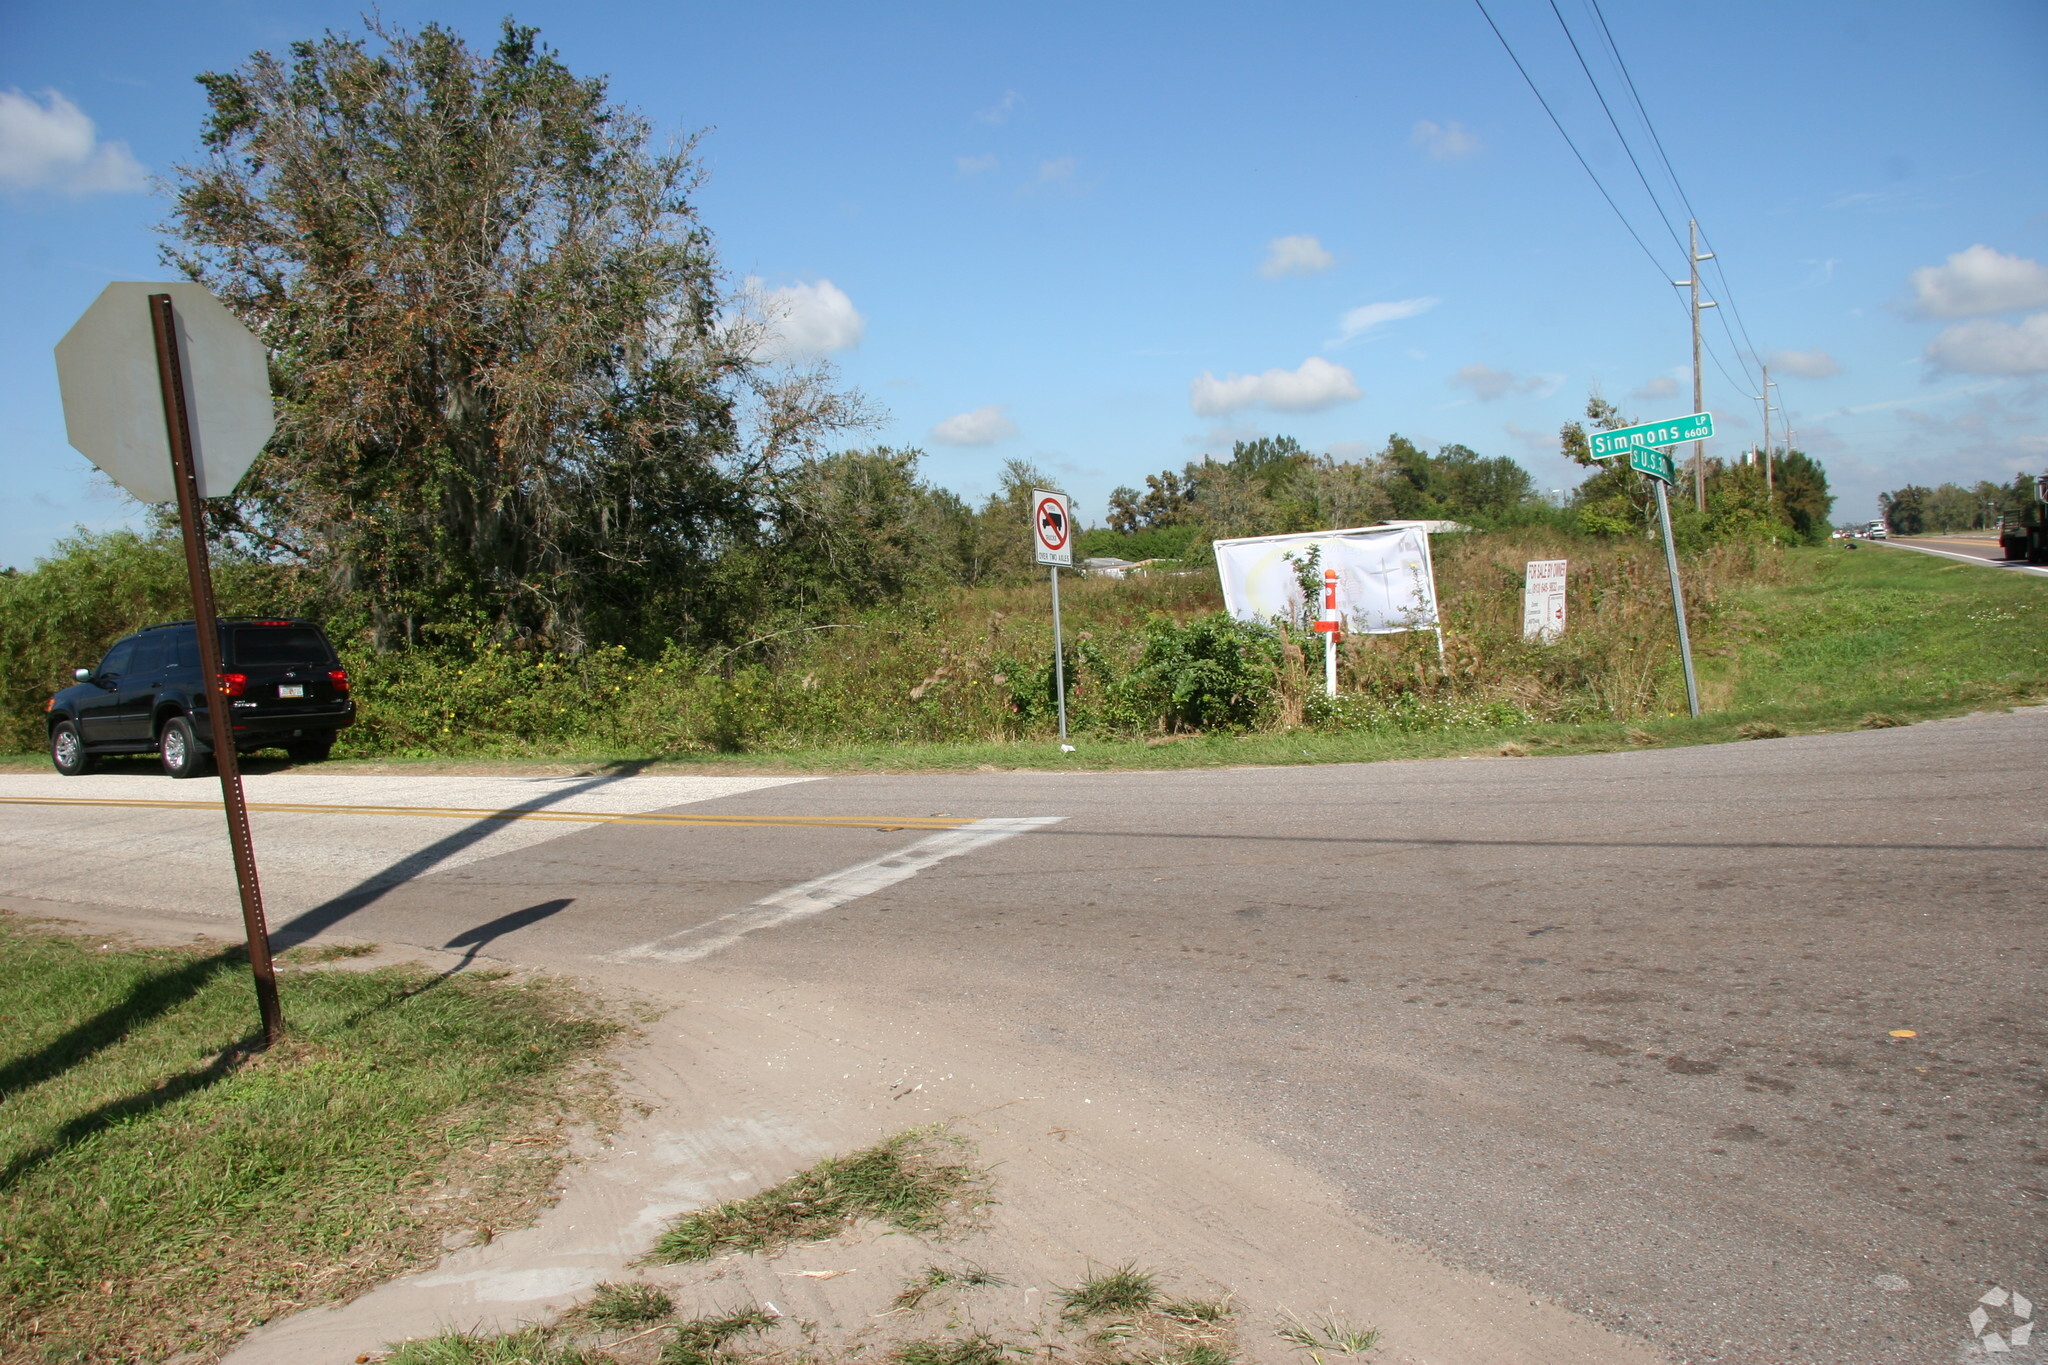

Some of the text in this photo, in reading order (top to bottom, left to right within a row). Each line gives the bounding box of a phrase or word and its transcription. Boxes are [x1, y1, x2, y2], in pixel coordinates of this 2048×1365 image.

[1695, 415, 1706, 426] LP
[1595, 426, 1709, 453] Simmons 6600
